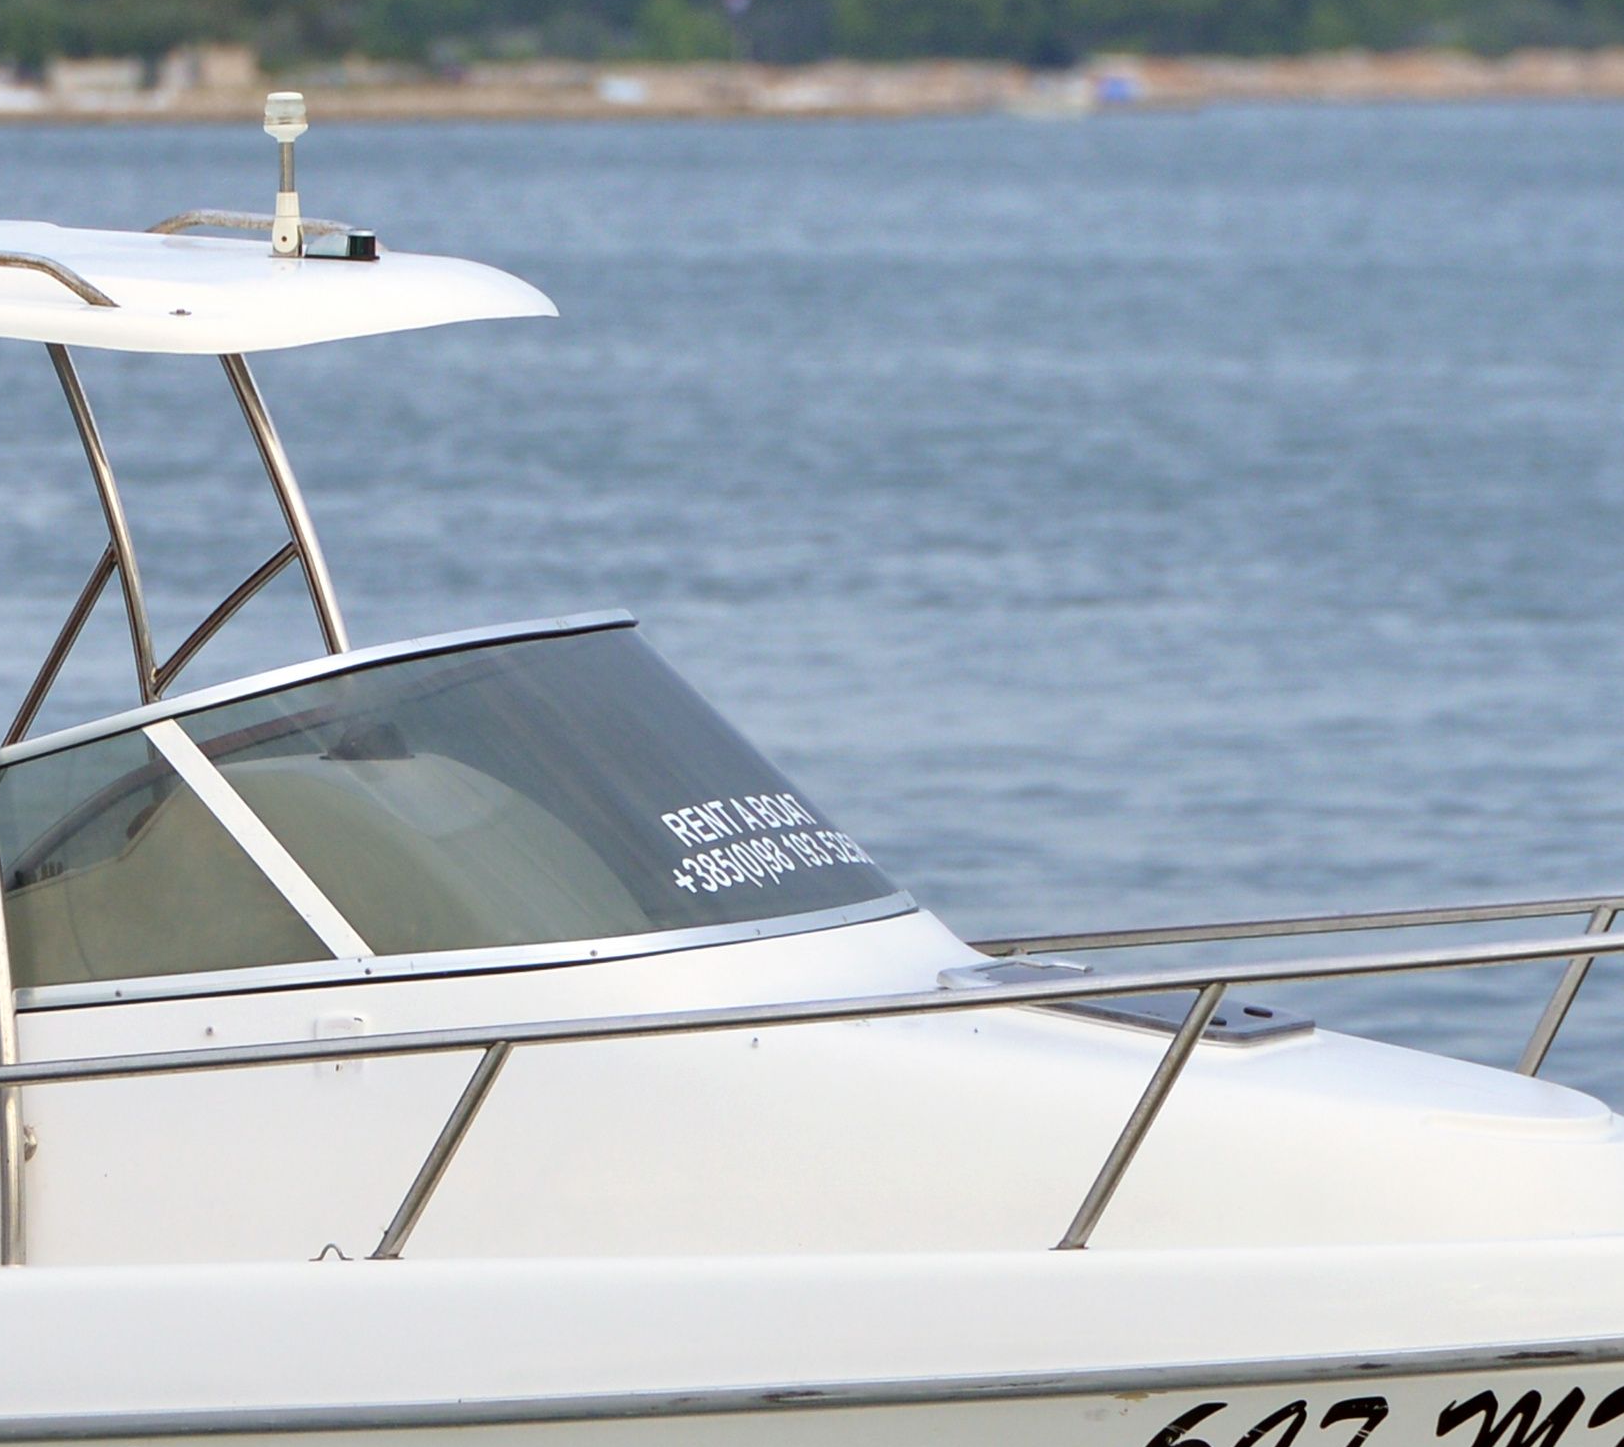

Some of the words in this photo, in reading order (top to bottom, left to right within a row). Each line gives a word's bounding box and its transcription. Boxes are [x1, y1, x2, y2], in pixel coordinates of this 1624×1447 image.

[660, 800, 743, 848] RENT
[730, 797, 759, 832] A
[751, 793, 817, 831] BOAT
[672, 835, 795, 894] +385(0)98
[783, 831, 835, 868] 193
